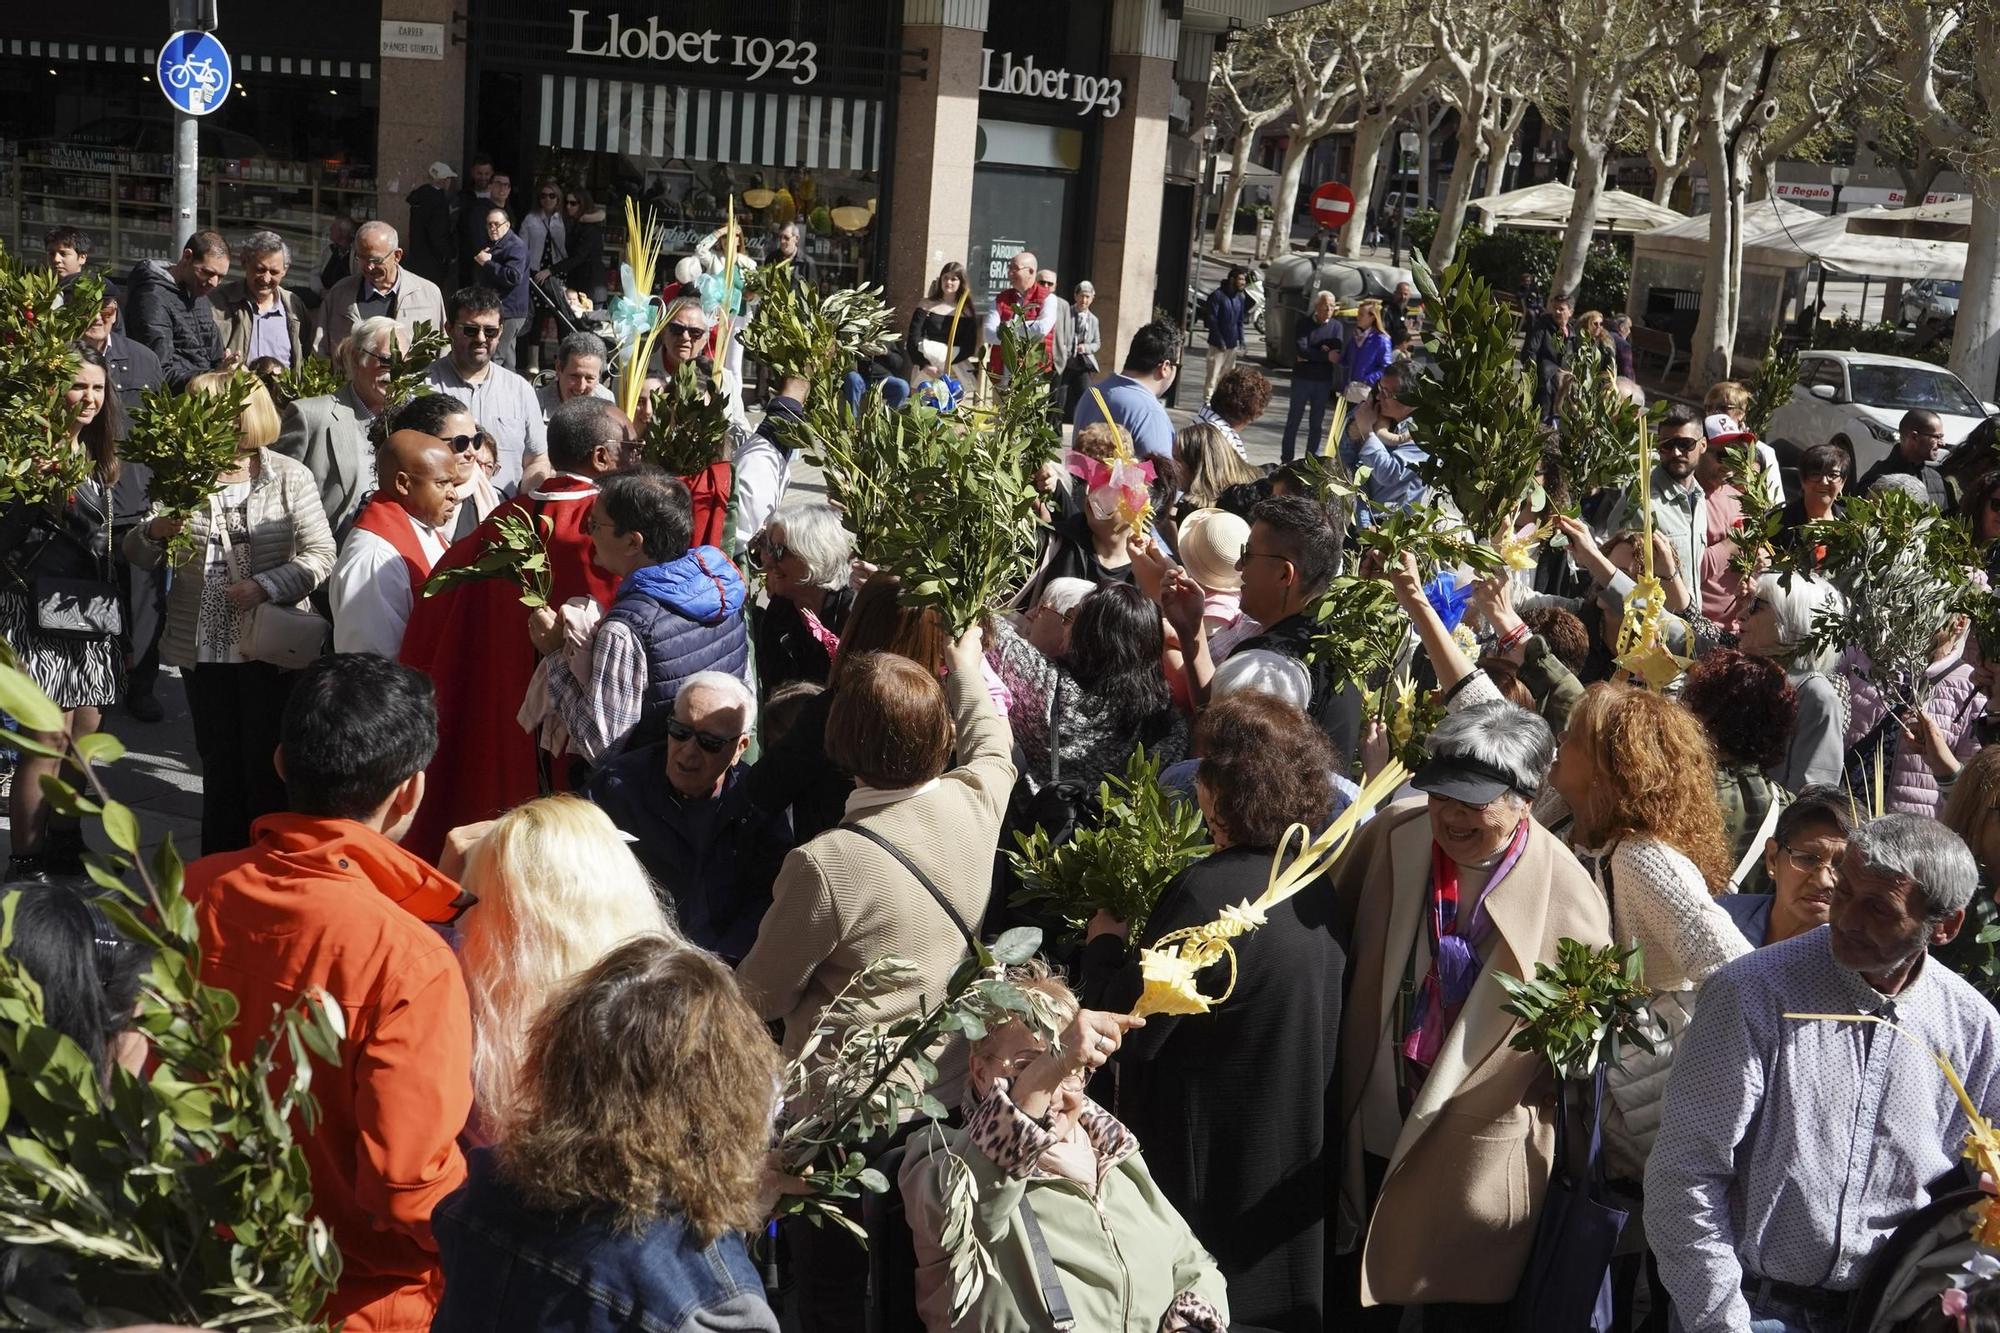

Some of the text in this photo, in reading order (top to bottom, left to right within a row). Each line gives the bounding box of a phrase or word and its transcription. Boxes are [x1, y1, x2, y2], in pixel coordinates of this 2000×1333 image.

[398, 26, 425, 37] CARRER
[566, 9, 818, 85] Llobet 1923
[978, 48, 1122, 118] Llobet 1923
[1777, 186, 1830, 198] El Regalo
[1888, 192, 1905, 203] Ba
[990, 260, 1010, 279] GRA
